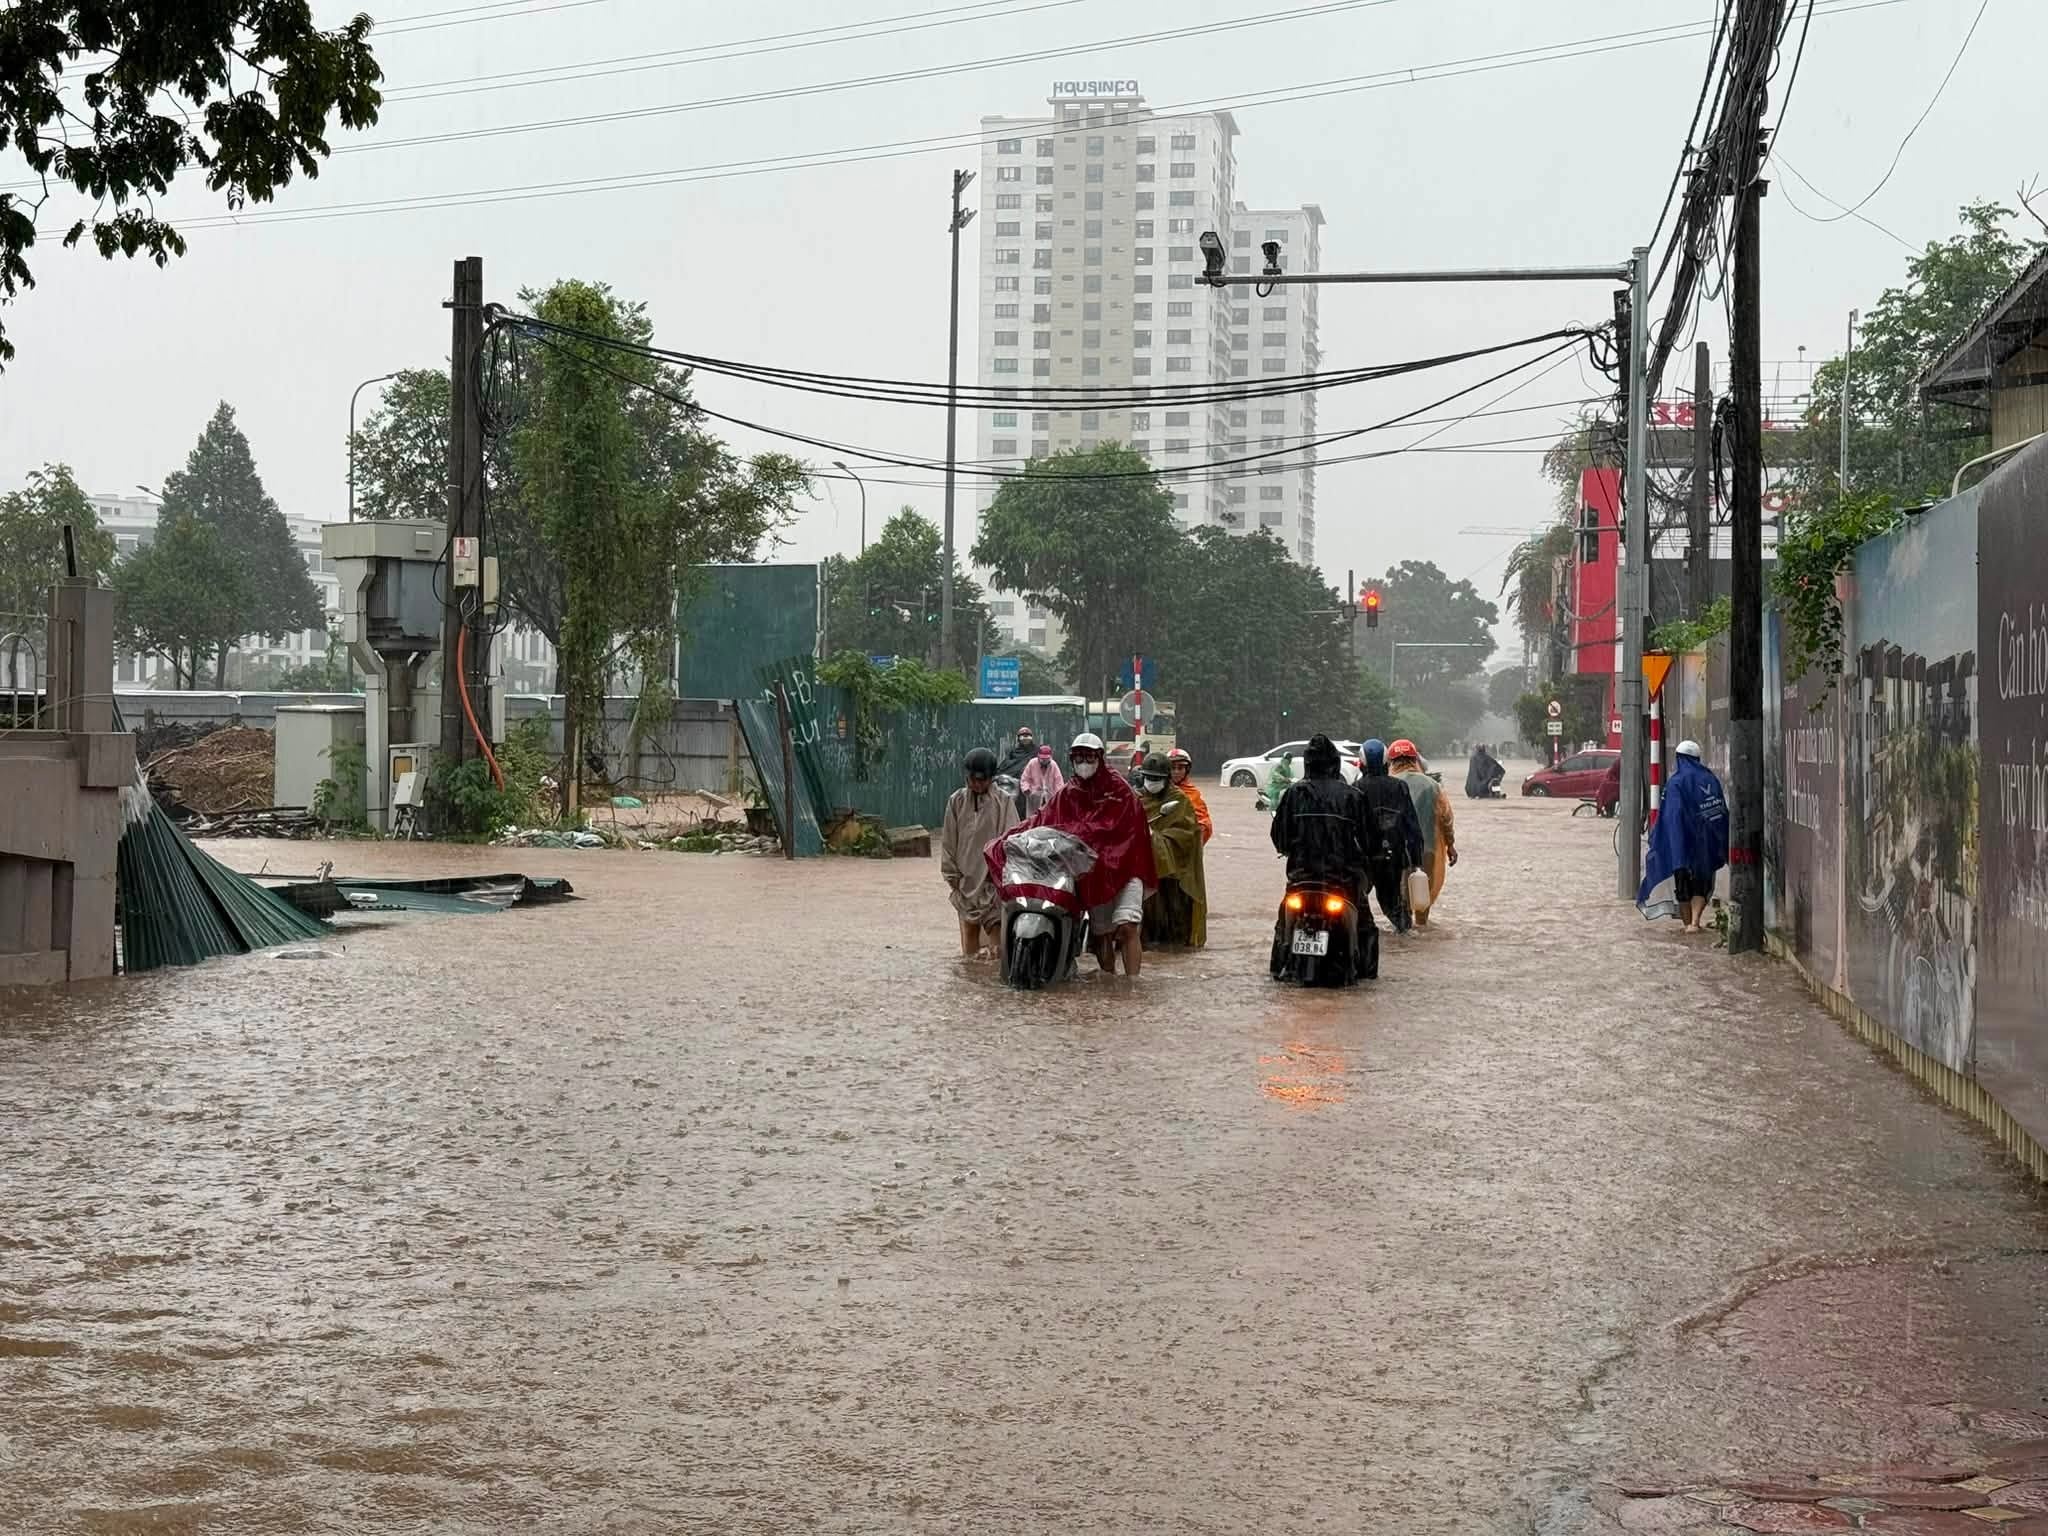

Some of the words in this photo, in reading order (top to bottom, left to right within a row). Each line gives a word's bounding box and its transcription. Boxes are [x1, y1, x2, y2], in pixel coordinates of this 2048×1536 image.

[1053, 80, 1138, 93] HOUSINCO
[1998, 611, 2025, 701] Căn
[2028, 603, 2048, 718] hộ
[2000, 738, 2029, 828] view
